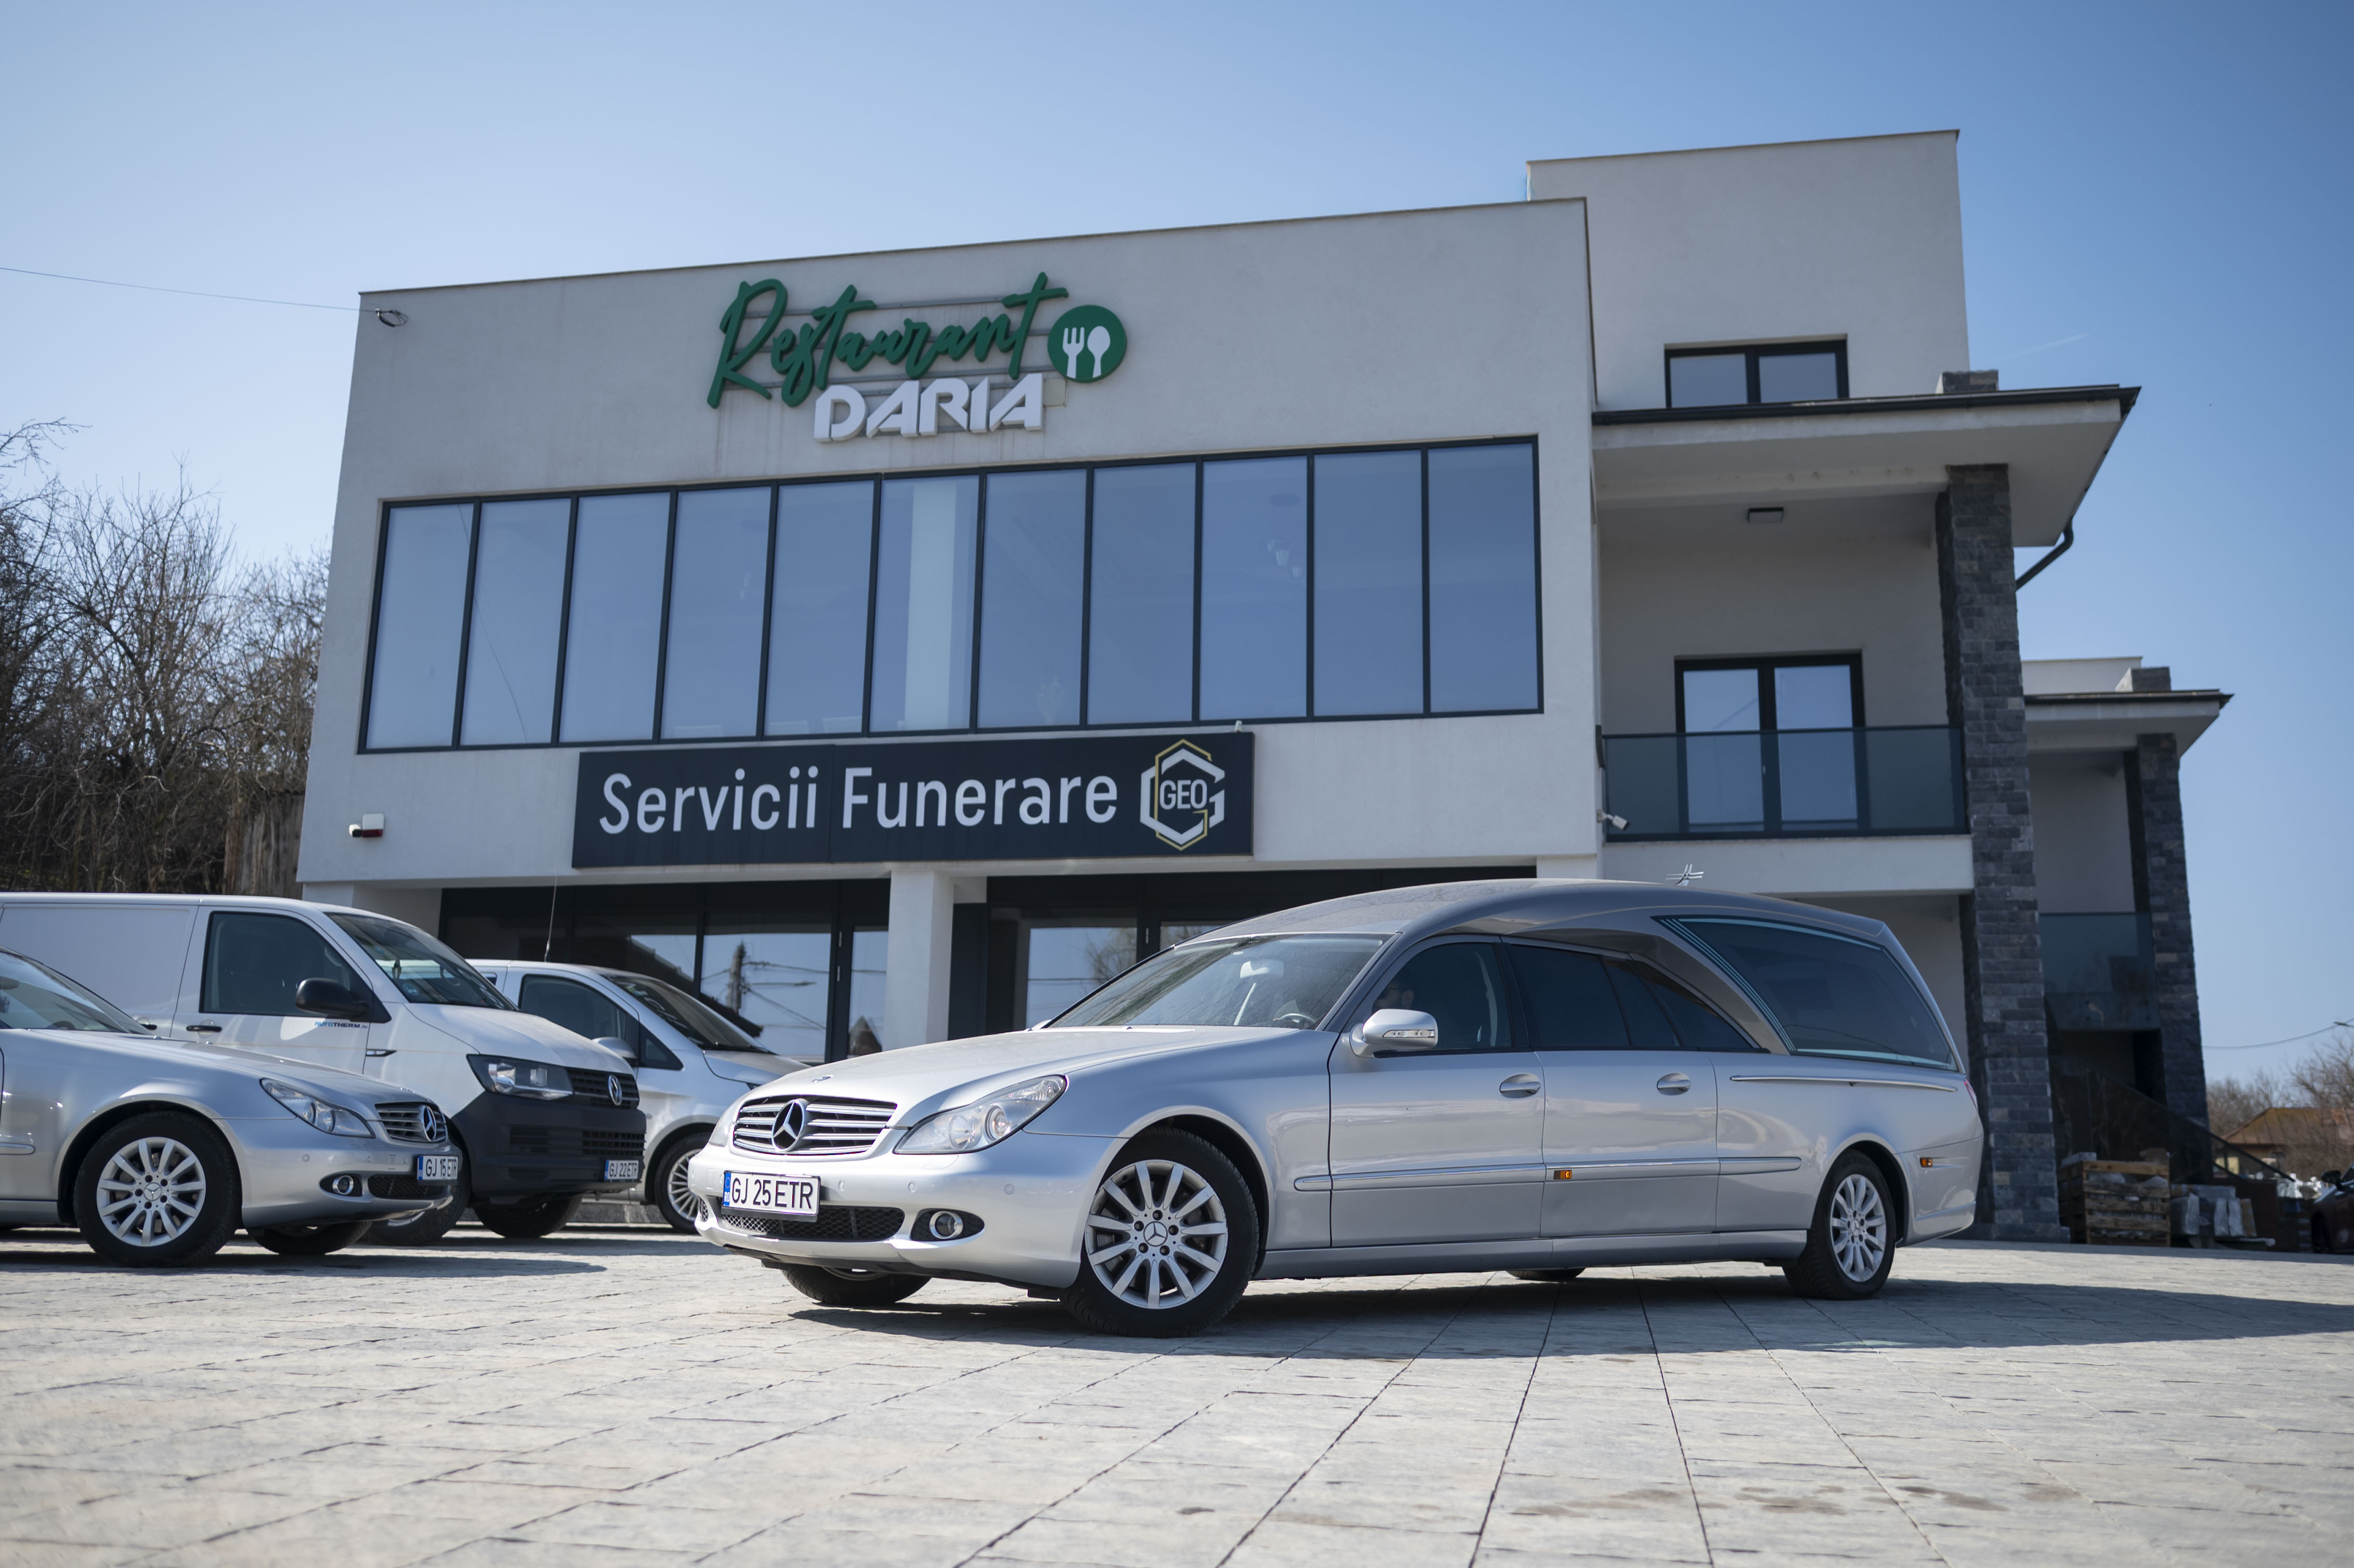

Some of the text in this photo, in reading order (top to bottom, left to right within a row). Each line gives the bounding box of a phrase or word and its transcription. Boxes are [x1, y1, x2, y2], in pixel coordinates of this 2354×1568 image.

[707, 271, 1069, 409] Restaurant
[814, 373, 1043, 443] DARIA
[599, 766, 1117, 834] Servicii Funerare
[1159, 779, 1208, 810] GEO
[426, 1158, 437, 1177] GJ
[440, 1158, 446, 1177] 15
[448, 1158, 457, 1177] ETR
[609, 1163, 637, 1177] GJ 22 ETR
[732, 1178, 813, 1209] GJ 25 ETR
